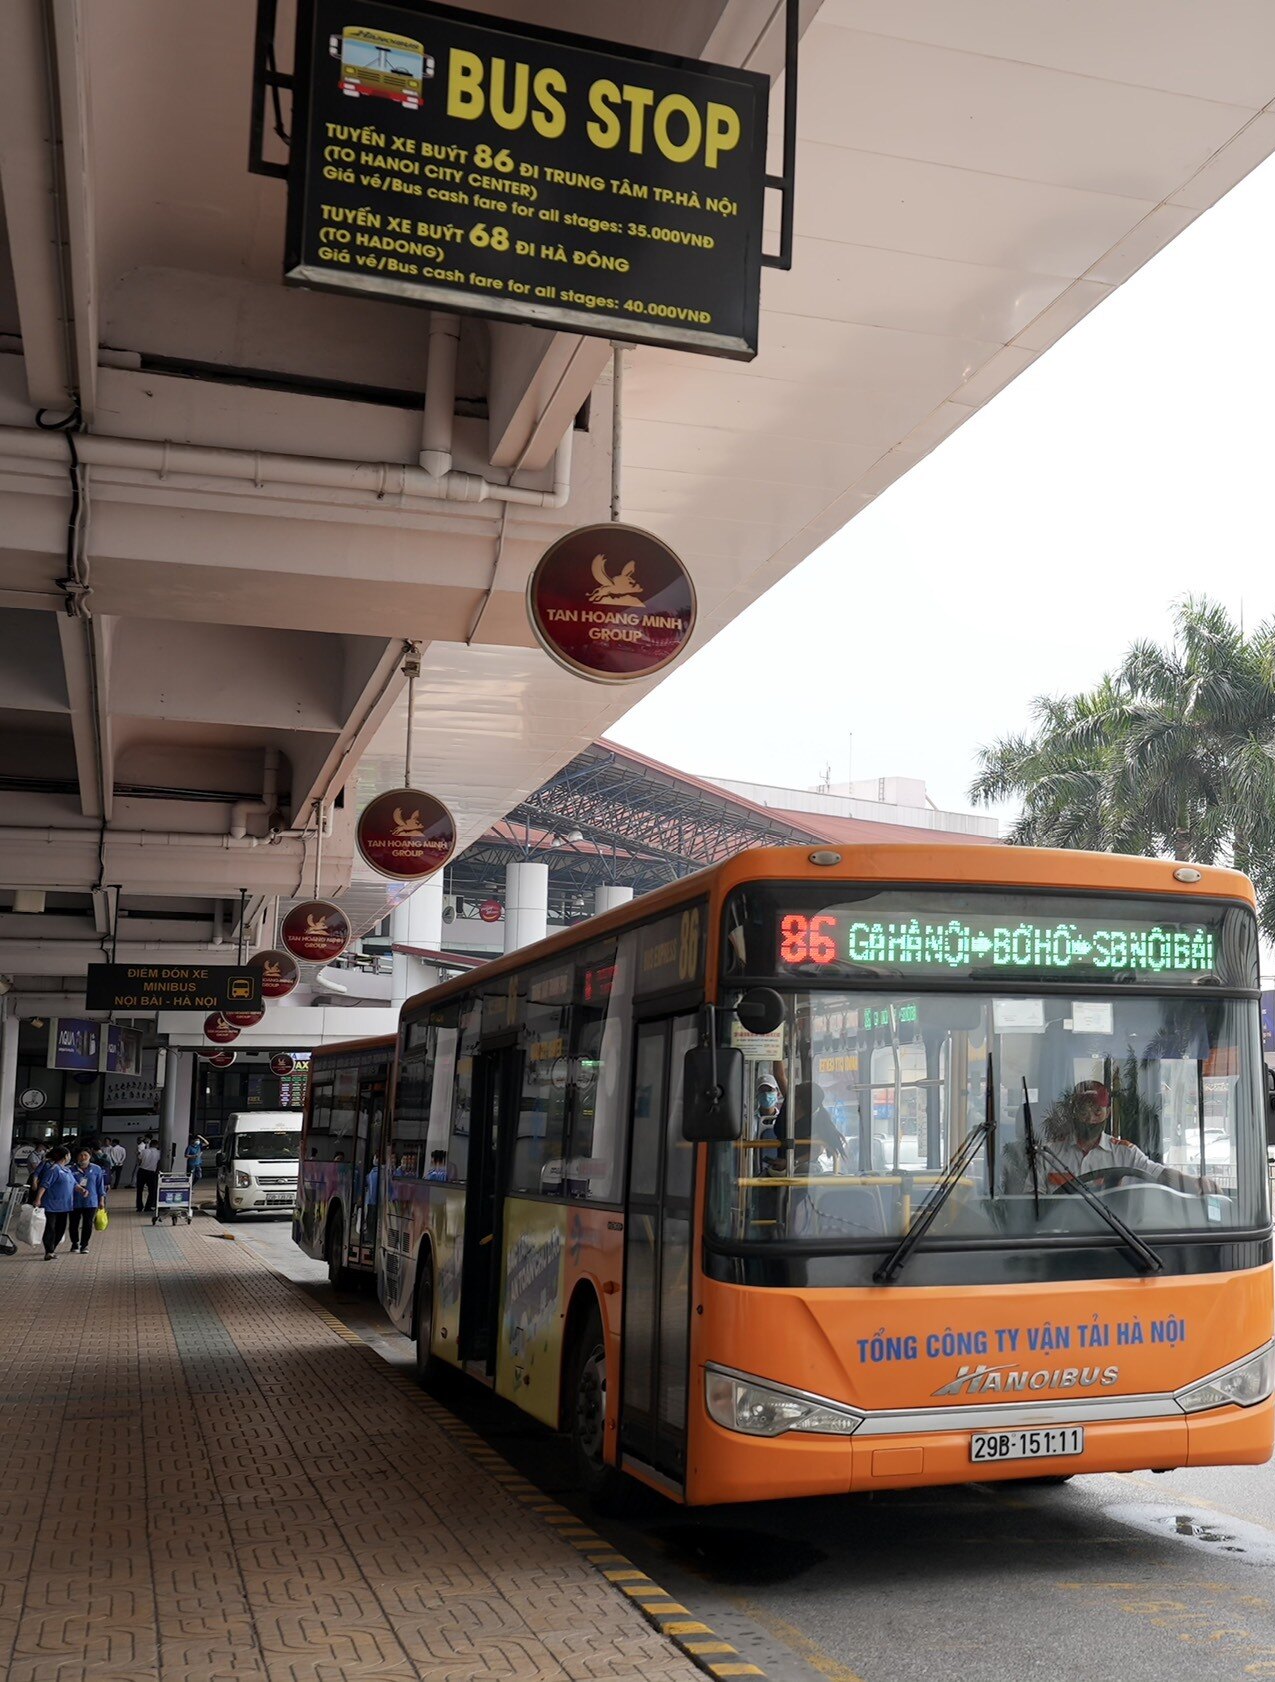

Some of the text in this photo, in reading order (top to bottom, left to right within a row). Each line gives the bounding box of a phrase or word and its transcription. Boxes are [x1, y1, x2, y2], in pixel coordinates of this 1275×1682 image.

[447, 49, 741, 168] BUS STOP
[324, 145, 538, 200] (TO HANOI CITY CENTER)
[325, 123, 385, 147] TUYẾN
[391, 136, 416, 154] XE
[421, 142, 468, 164] BUÝT
[473, 144, 514, 173] 86
[519, 162, 539, 179] ĐI
[544, 168, 605, 191] TRUNG
[610, 178, 648, 199] TÂM
[706, 197, 738, 217] NỘI
[323, 166, 355, 183] Giá
[360, 173, 423, 196] vé/Bus
[427, 187, 469, 205] cash
[473, 194, 507, 212] fare
[512, 202, 535, 217] for
[539, 208, 559, 222] all
[564, 213, 622, 233] stages:
[319, 227, 444, 262] (TO HADONG)
[321, 205, 630, 272] TUYẾN XE BUÝT 68 ĐI HÀ ĐÔNG
[318, 247, 350, 264] Giá
[356, 255, 418, 275] vé/Bus
[423, 266, 465, 283] cash
[469, 273, 503, 288] fare
[507, 279, 531, 296] for
[535, 287, 555, 299] all
[560, 290, 619, 308] stages:
[547, 609, 682, 629] TAN HOANG MINH
[589, 628, 642, 642] GROUP
[781, 914, 837, 964] 86
[144, 983, 197, 991] MINIBUS
[192, 970, 208, 978] XE
[141, 994, 162, 1005] BÀI
[174, 995, 191, 1006] HÀ
[857, 1313, 1185, 1363] TỔNG CÔNG TY VẬN TẢI HÀ NỘI
